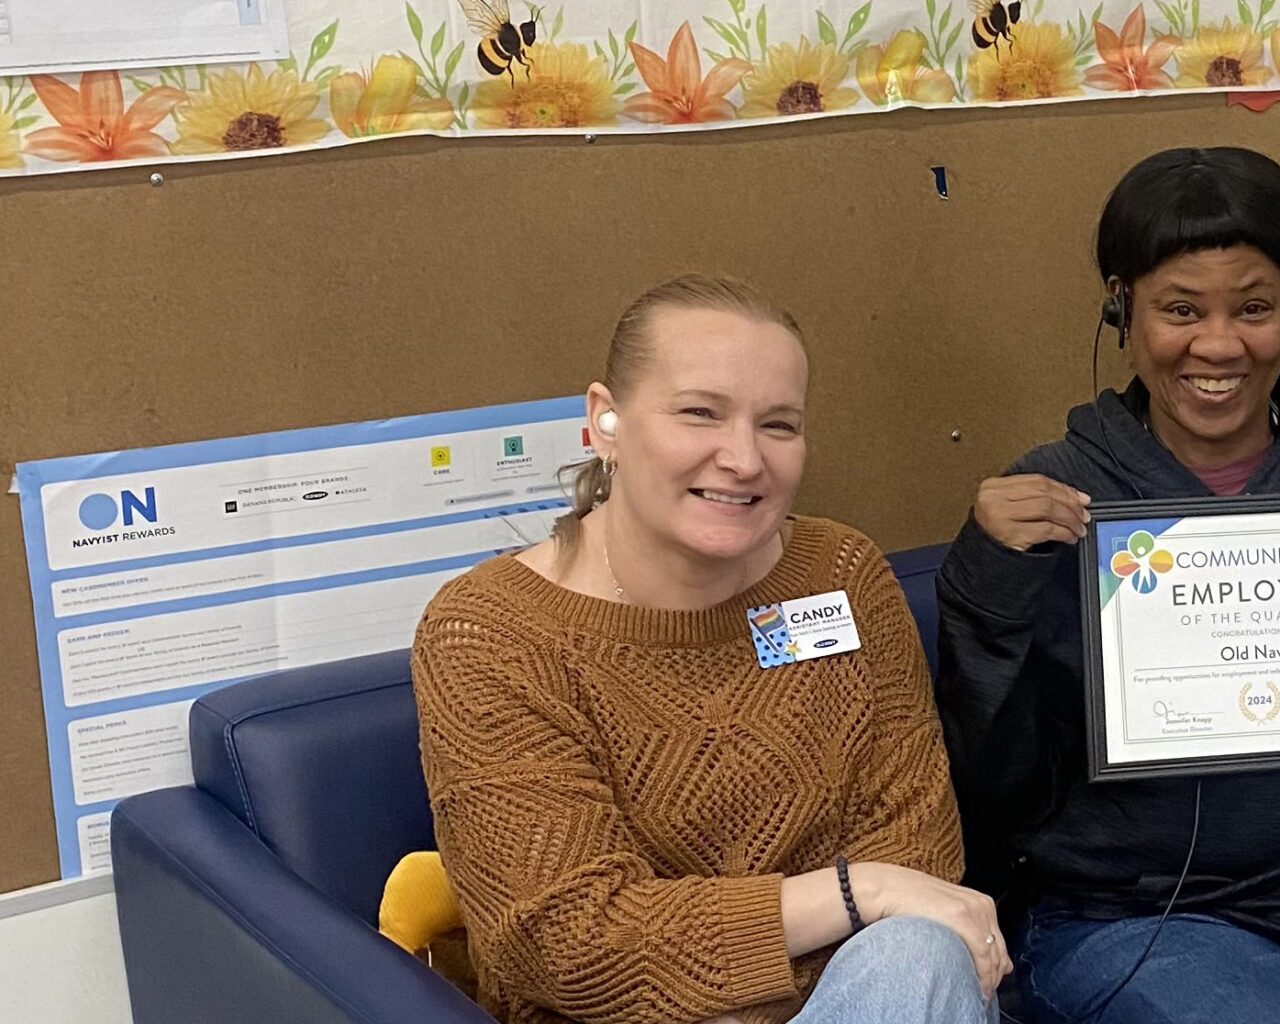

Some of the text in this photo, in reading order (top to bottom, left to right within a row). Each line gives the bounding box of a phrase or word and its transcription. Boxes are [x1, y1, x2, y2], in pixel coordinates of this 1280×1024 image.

[72, 526, 176, 548] NAVYIST REWARDS
[790, 603, 842, 624] CANDY
[1181, 614, 1202, 626] OF
[1211, 612, 1242, 624] THE
[1220, 646, 1249, 662] Old
[1248, 695, 1272, 706] 2024
